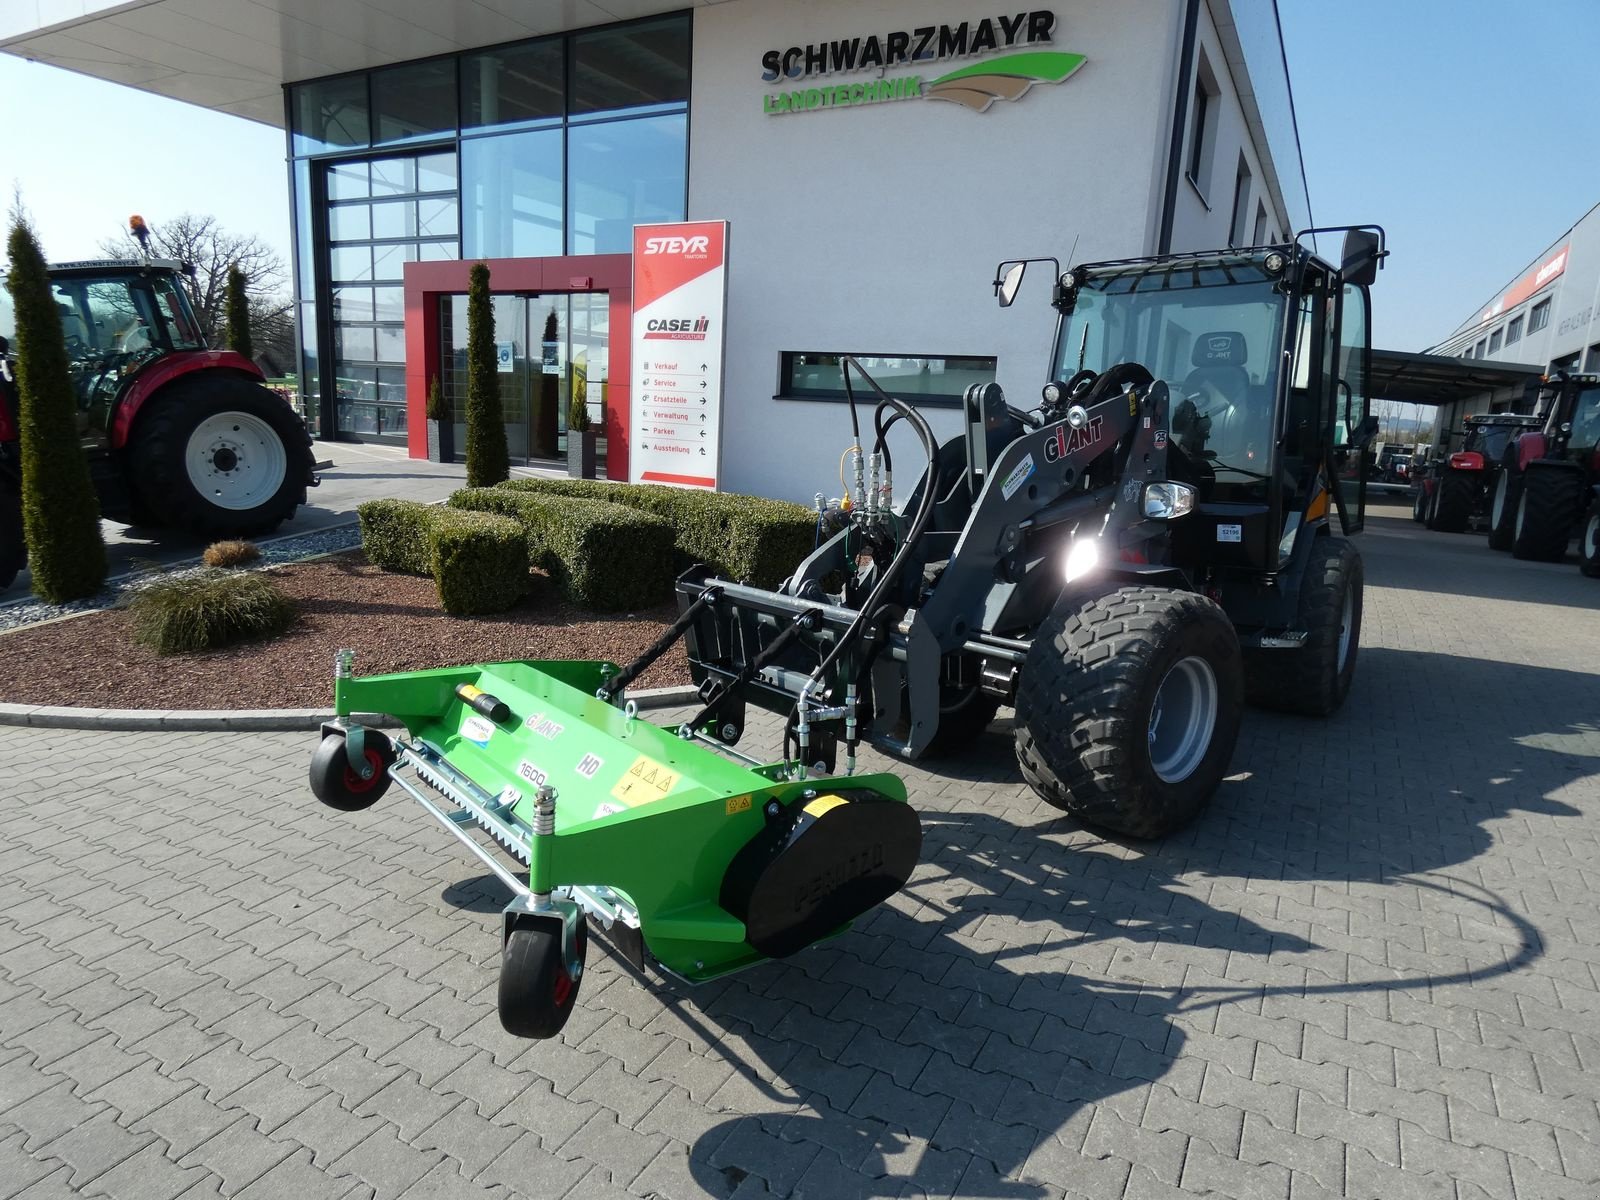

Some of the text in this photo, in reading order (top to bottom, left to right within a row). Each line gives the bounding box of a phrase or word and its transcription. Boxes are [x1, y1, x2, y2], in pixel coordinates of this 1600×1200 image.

[761, 10, 1057, 83] SCHWARZMAYR
[763, 76, 923, 115] LANDTECHNIK
[644, 236, 709, 254] STEYR
[647, 319, 691, 332] CASE
[654, 363, 678, 371] Verkauf
[654, 379, 676, 388] Service
[653, 395, 688, 405] Ersatzteile
[653, 411, 689, 421] Verwaltung
[653, 427, 675, 436] Parken
[653, 444, 690, 454] Ausstellung
[578, 755, 600, 777] HD
[520, 762, 545, 786] 1600
